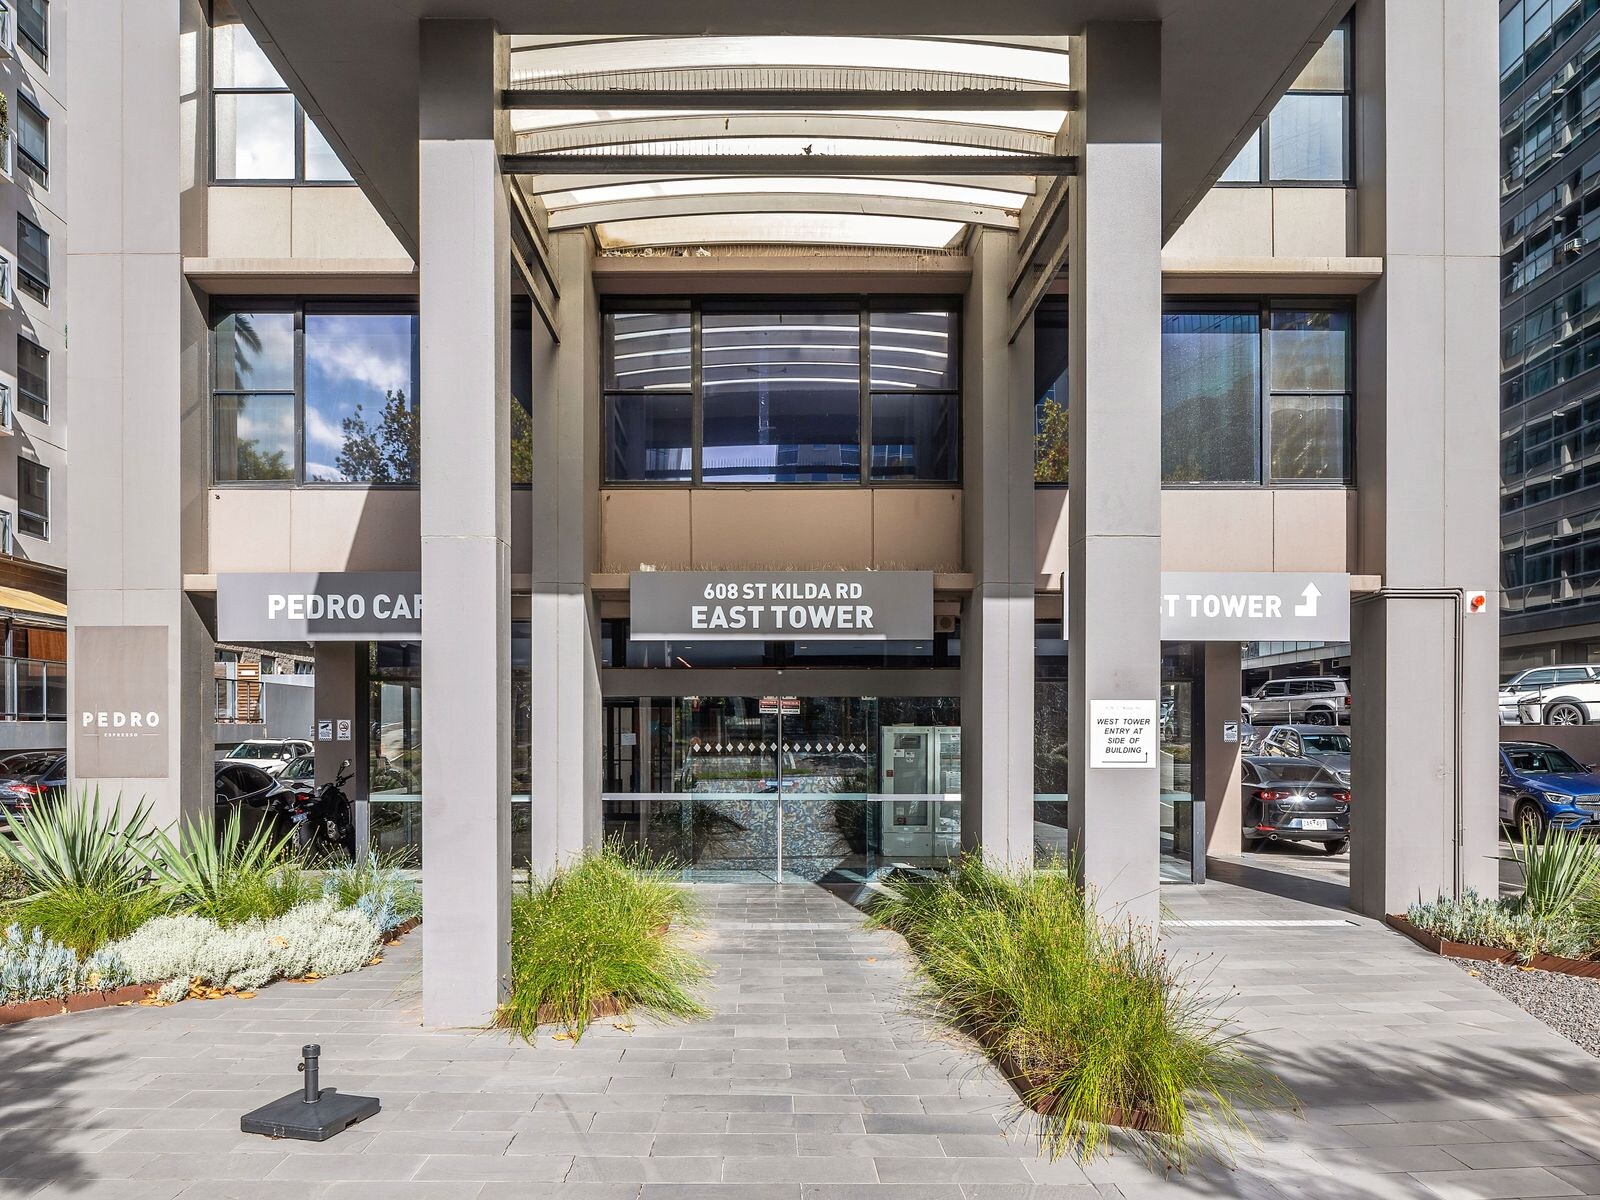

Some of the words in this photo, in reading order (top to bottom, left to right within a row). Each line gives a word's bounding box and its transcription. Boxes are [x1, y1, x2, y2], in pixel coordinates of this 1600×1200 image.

[703, 583, 738, 599] 608
[742, 583, 767, 599] ST
[771, 583, 832, 599] KILDA
[836, 583, 863, 599] RD
[268, 594, 366, 620] PEDRO
[1186, 594, 1282, 618] TOWER
[691, 605, 765, 629] EAST
[771, 605, 874, 629] TOWER
[82, 711, 160, 727] PEDRO
[1105, 746, 1142, 754] BUILDING
